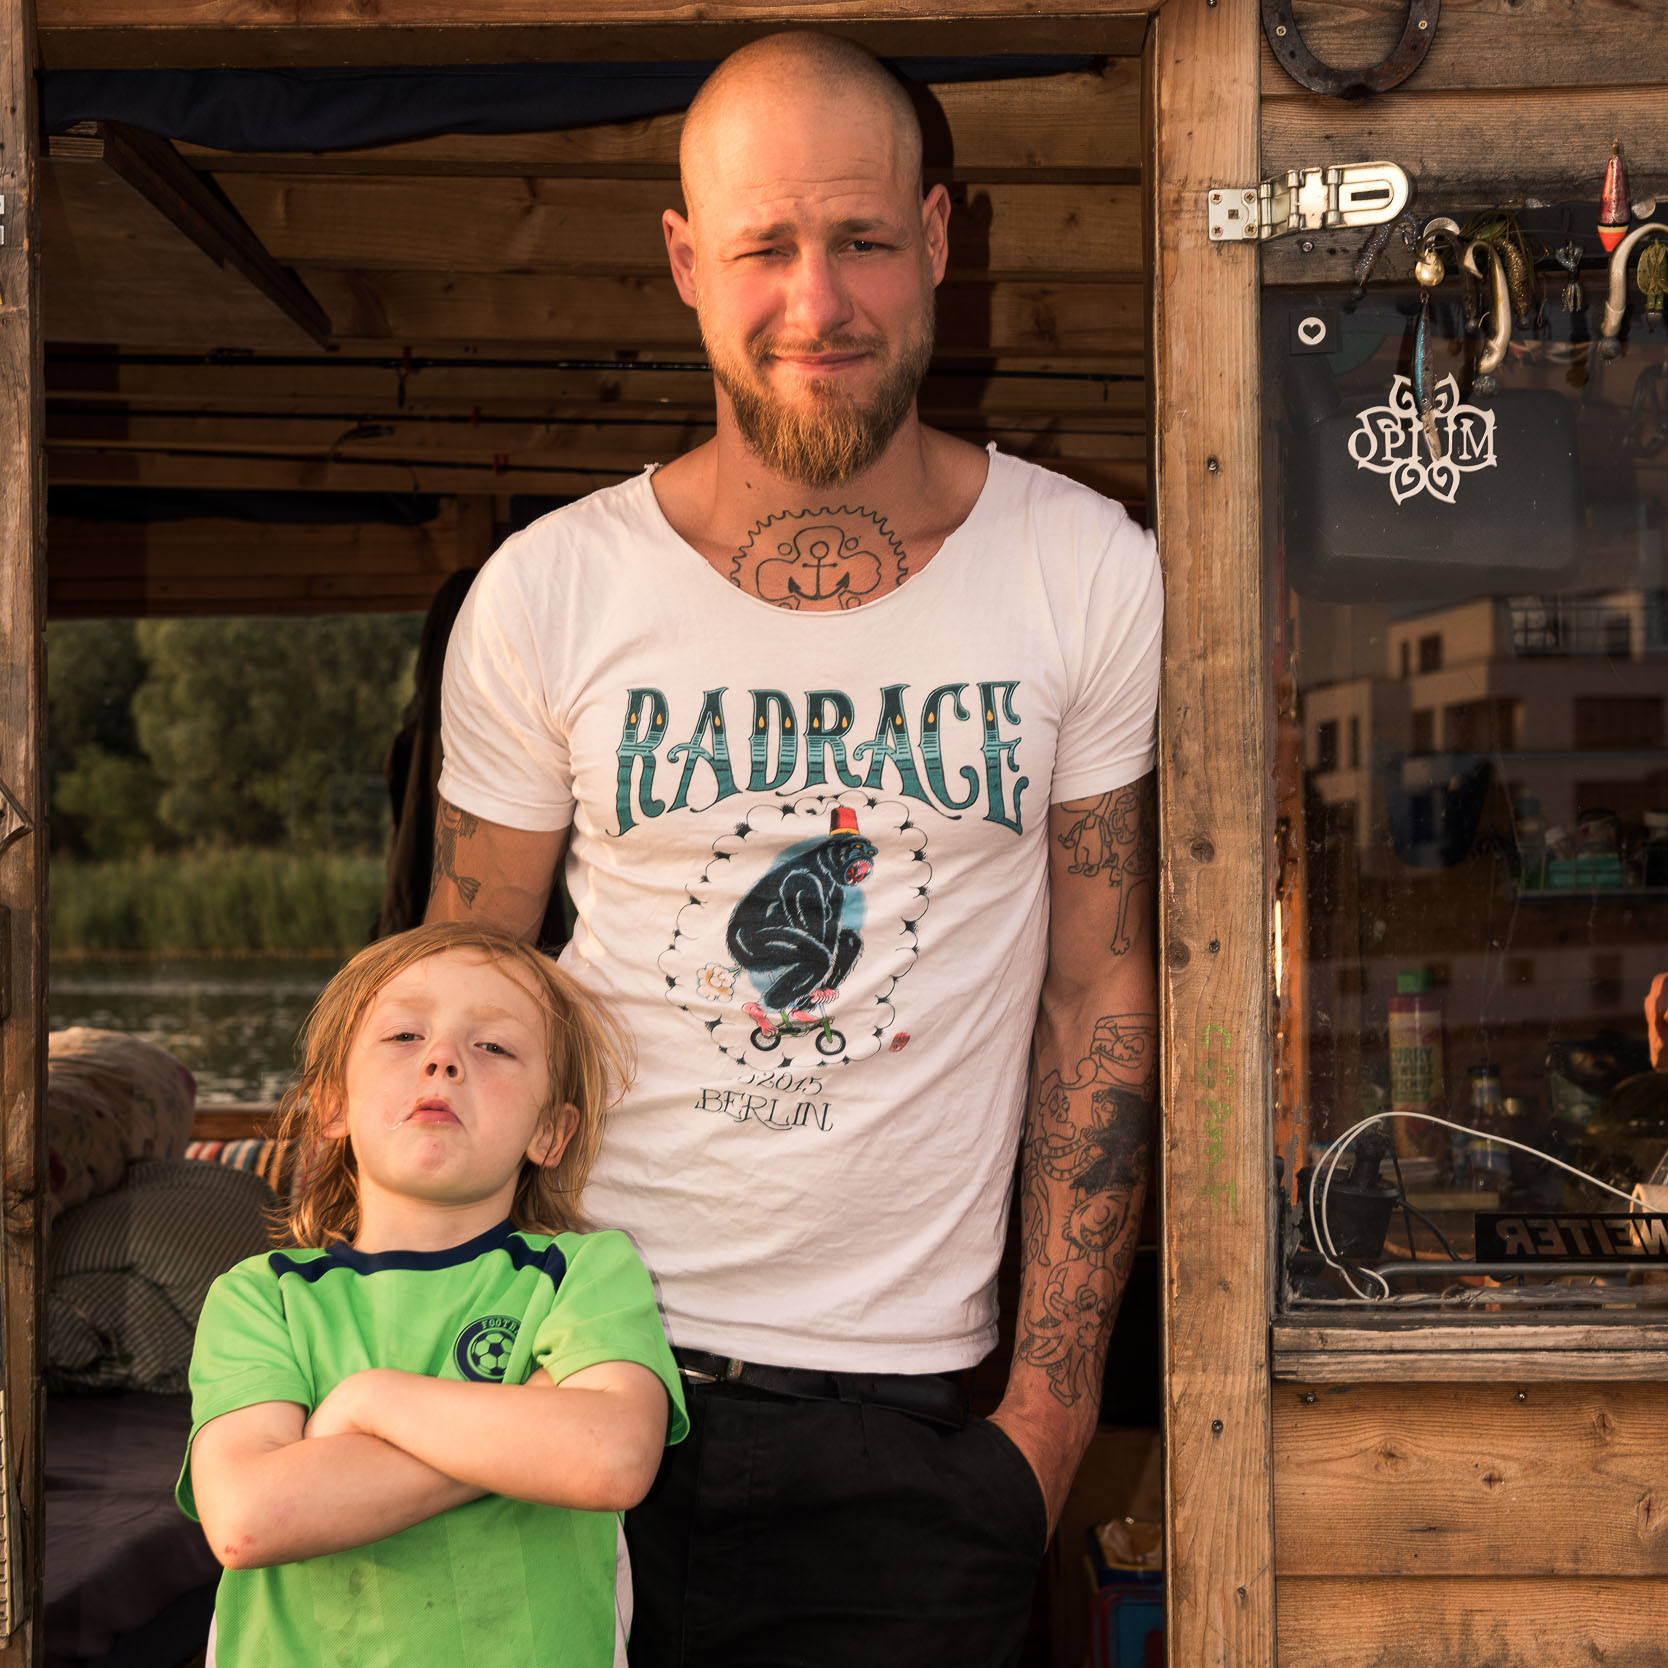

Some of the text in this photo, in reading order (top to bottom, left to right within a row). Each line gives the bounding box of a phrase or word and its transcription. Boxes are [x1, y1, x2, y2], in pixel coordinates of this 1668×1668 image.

[1348, 416, 1498, 463] OPIUM
[606, 681, 1029, 837] RADRACE
[694, 1087, 834, 1132] BERLIN
[481, 1318, 519, 1335] FOOTB
